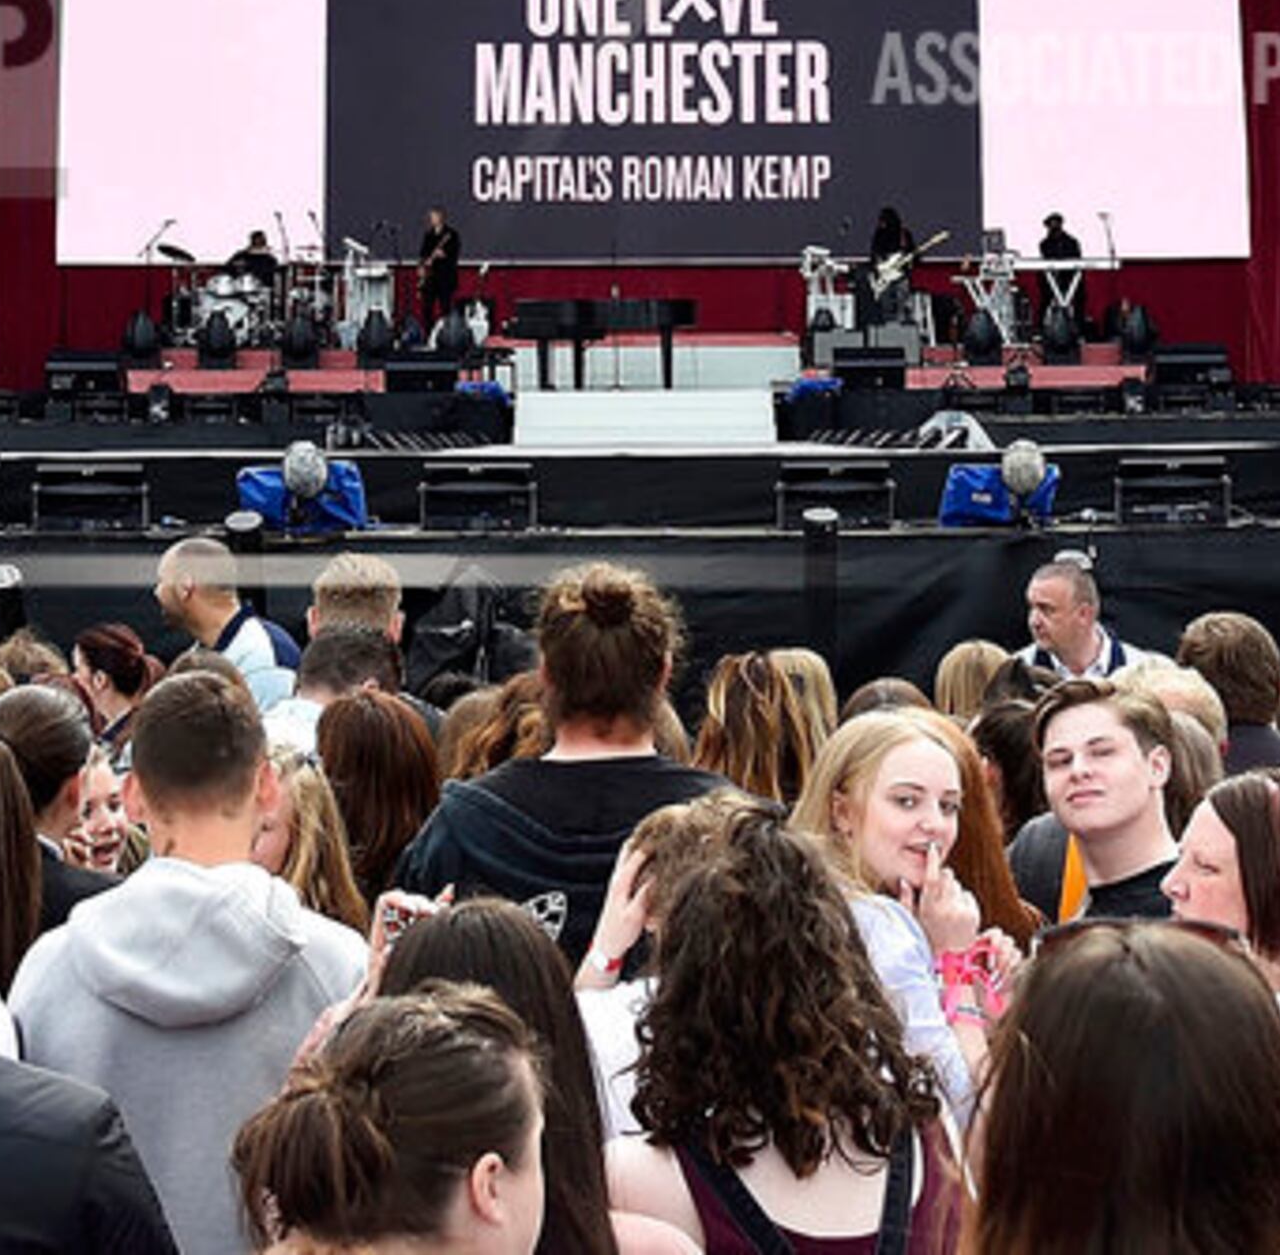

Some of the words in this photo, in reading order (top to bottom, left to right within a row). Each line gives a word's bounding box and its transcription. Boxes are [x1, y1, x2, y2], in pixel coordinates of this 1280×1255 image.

[475, 42, 830, 125] MANCHESTER
[472, 156, 613, 202] CAPITAL'S
[622, 156, 733, 201] ROMAN
[743, 155, 831, 200] KEMP
